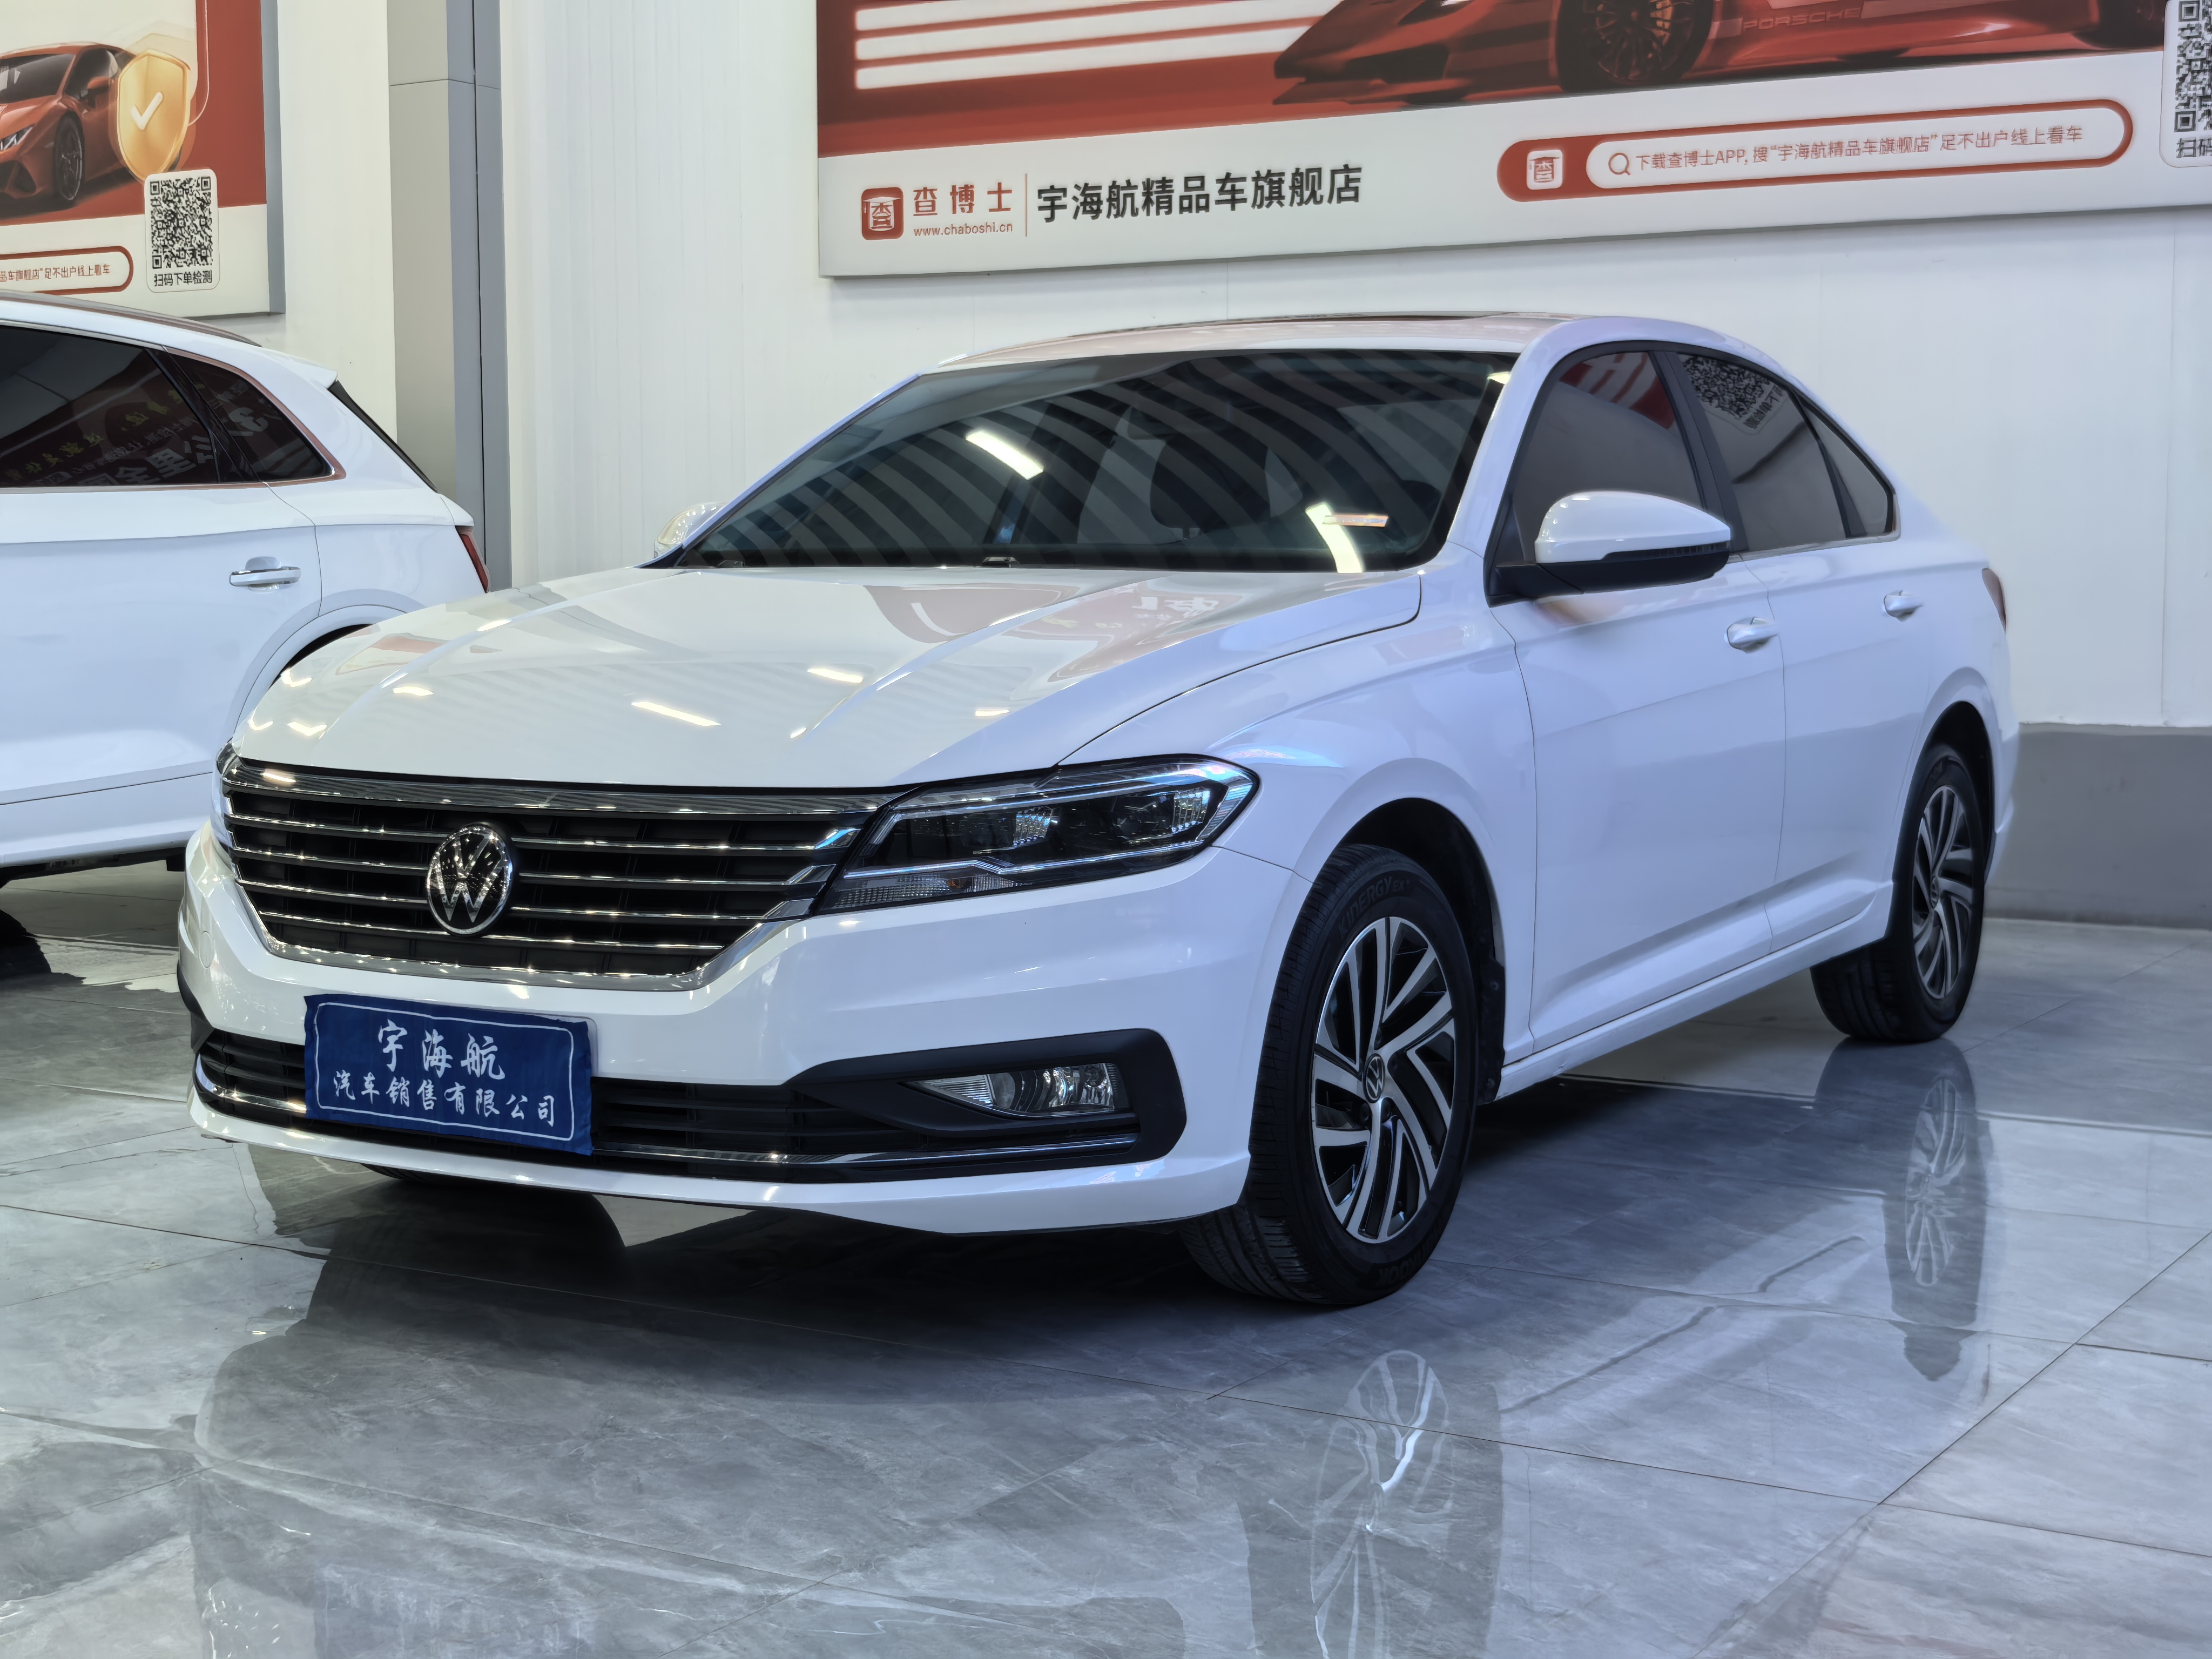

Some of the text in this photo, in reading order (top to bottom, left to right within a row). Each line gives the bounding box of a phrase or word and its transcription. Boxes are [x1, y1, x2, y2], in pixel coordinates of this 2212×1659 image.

[1743, 6, 1862, 30] PORSCHE
[1037, 164, 1362, 223] 宇海航精品车旗舰店
[913, 221, 1013, 237] www.chaboshi.cn
[154, 270, 212, 287] 扫码下单检测
[1338, 876, 1392, 941] KINERGY
[377, 1019, 506, 1080] 宇海航
[333, 1069, 555, 1128] 汽车销售有限公司
